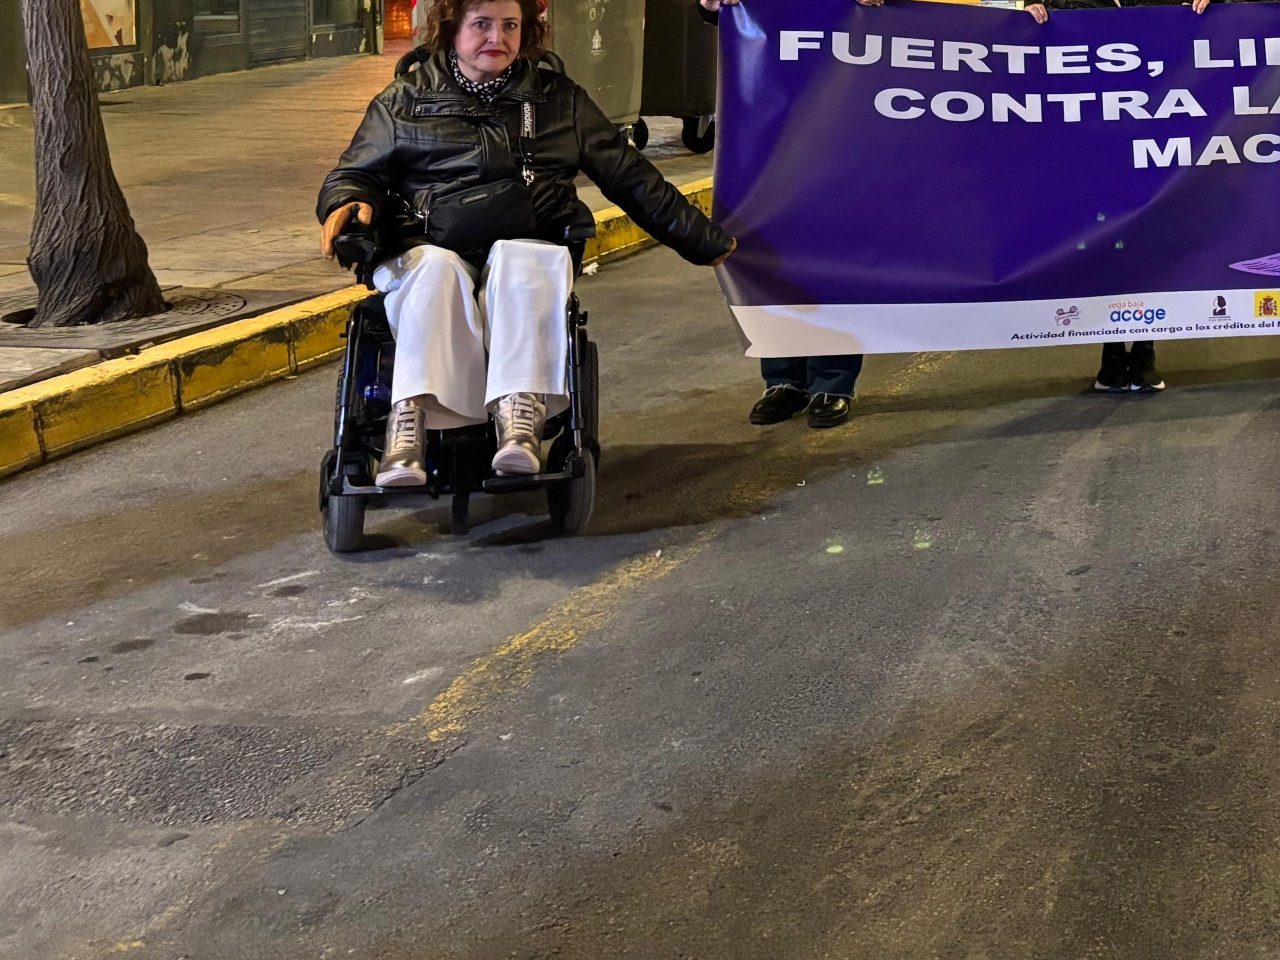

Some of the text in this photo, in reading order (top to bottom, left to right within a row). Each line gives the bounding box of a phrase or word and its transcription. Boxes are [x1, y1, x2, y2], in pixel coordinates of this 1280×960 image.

[779, 29, 1164, 77] FUERTES,
[874, 87, 1207, 123] CONTRA
[1108, 300, 1144, 310] vega baja
[1110, 308, 1166, 324] acoge
[1011, 331, 1065, 340] Actividad
[1068, 327, 1126, 337] financiada
[1151, 326, 1183, 335] cargo
[1213, 321, 1255, 330] créditos
[1258, 320, 1275, 328] del
